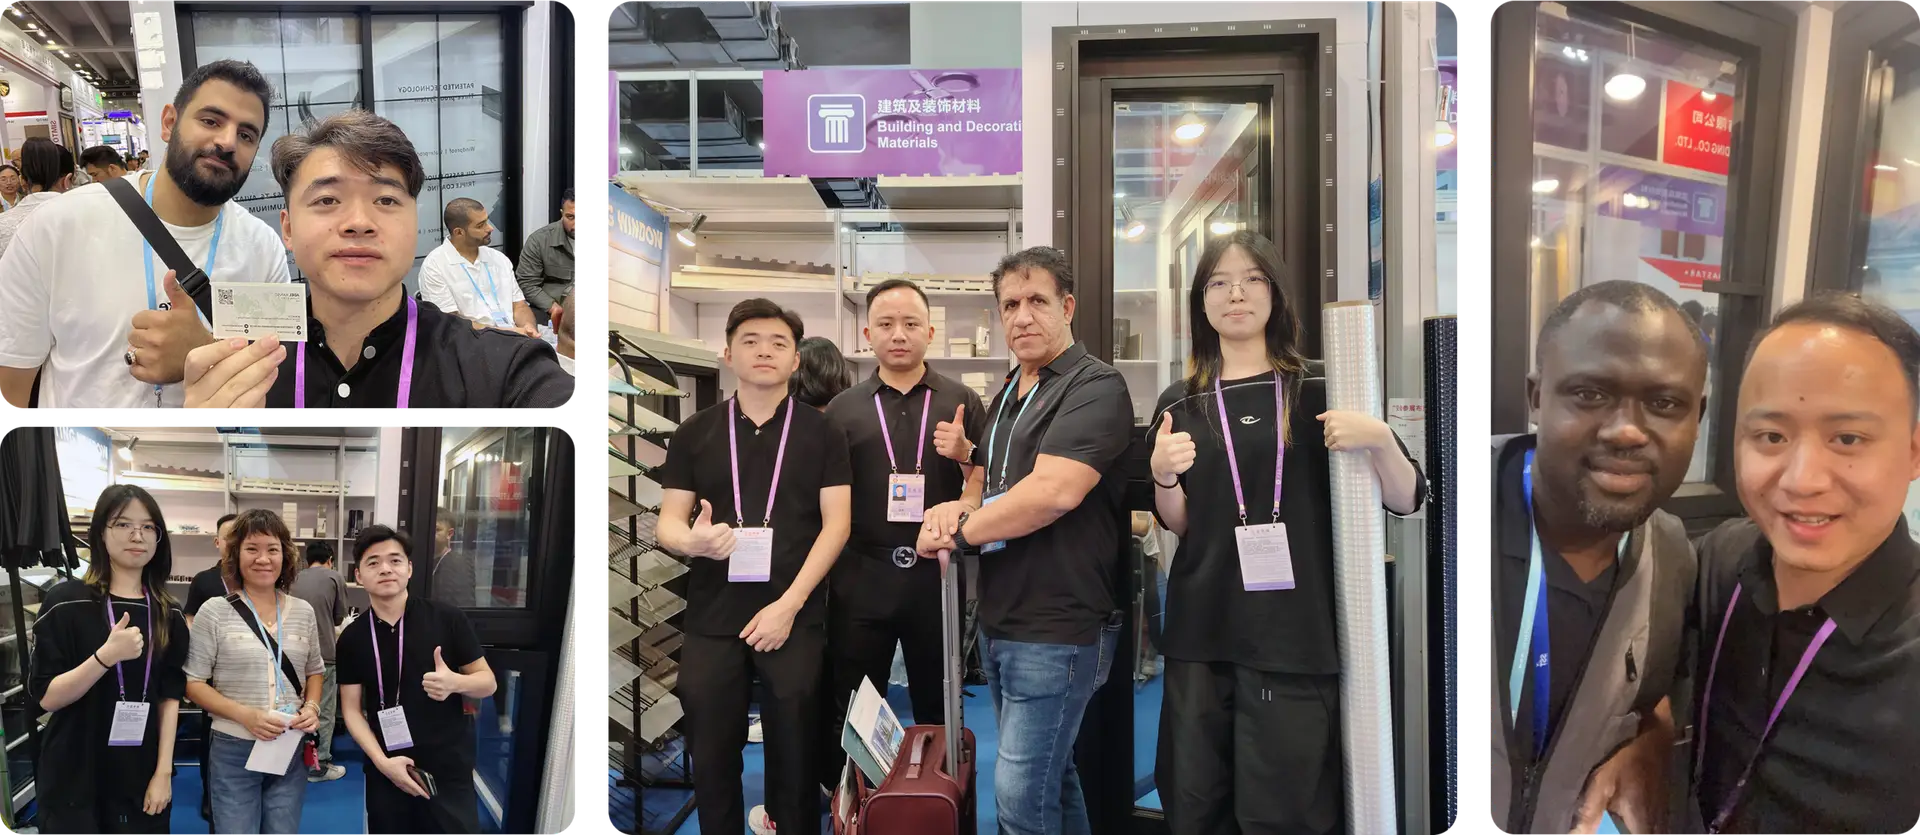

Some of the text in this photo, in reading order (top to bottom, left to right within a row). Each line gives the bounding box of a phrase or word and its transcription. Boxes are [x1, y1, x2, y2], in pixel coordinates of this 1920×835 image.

[877, 98, 982, 114] 建筑及装饰材料
[877, 120, 934, 134] Building
[937, 120, 962, 132] and
[877, 137, 938, 148] Materials
